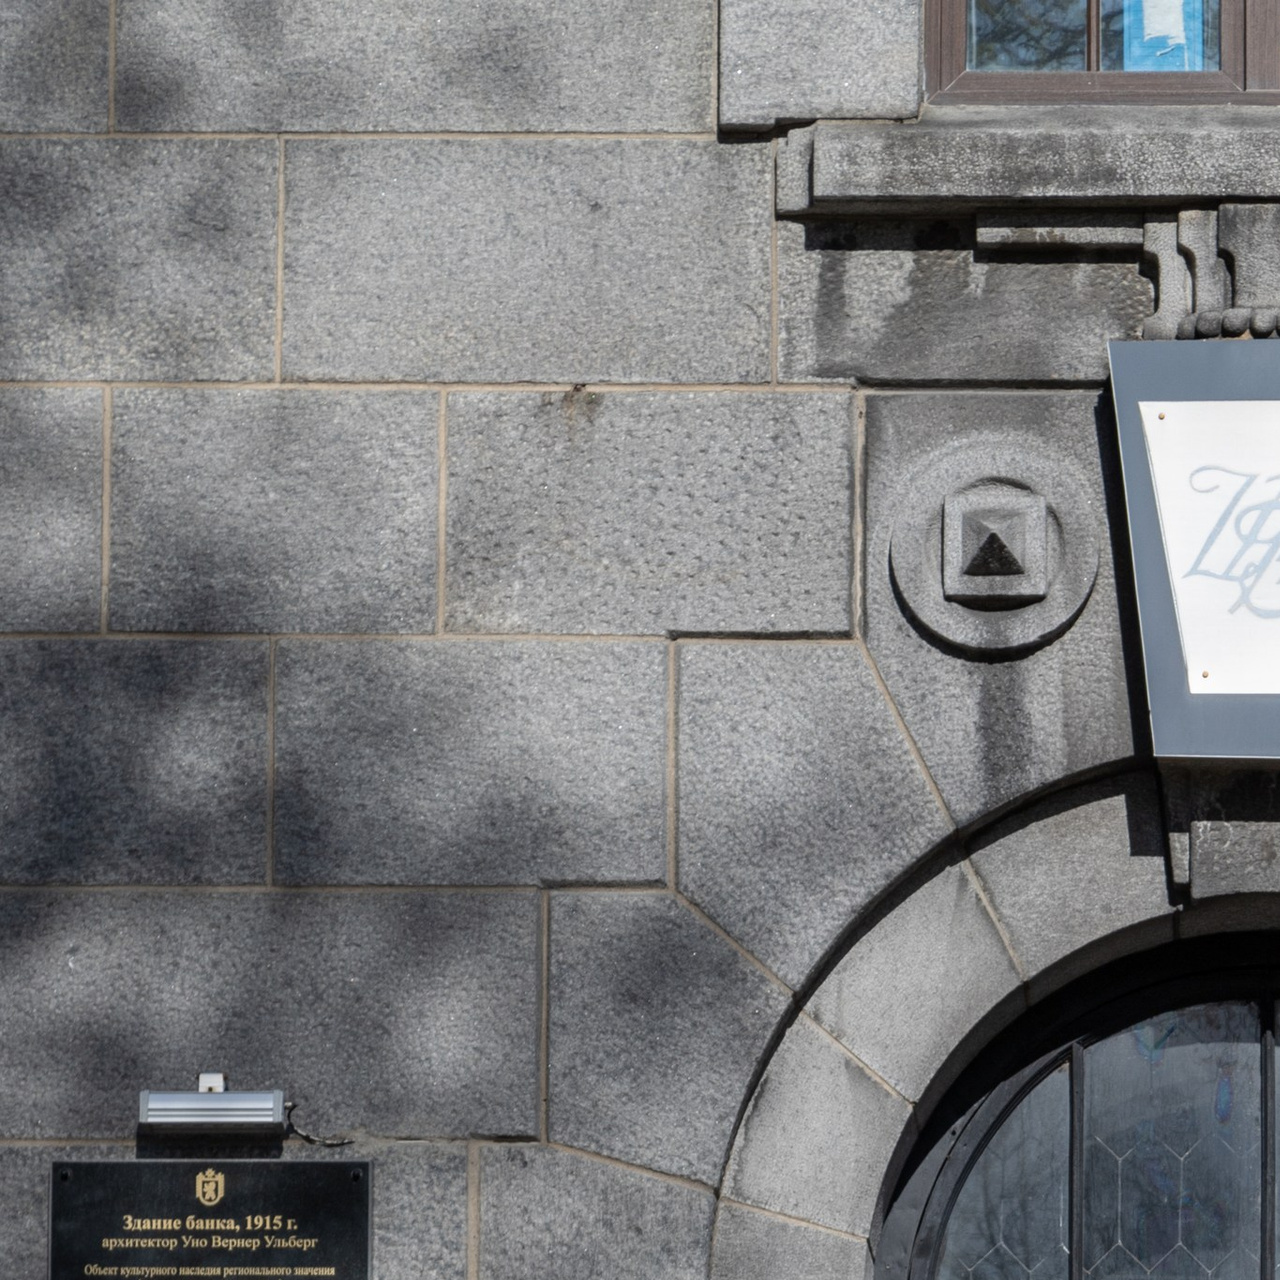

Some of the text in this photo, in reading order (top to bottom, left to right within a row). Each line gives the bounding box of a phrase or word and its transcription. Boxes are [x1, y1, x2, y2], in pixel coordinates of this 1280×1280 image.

[122, 1214, 299, 1233] Здание банка, 1915 г.
[101, 1235, 319, 1251] архитектор Уно Вернер Ульберг
[120, 1266, 178, 1279] культурного
[178, 1265, 222, 1277] наследия
[222, 1265, 292, 1279] регионального
[293, 1266, 336, 1277] значения
